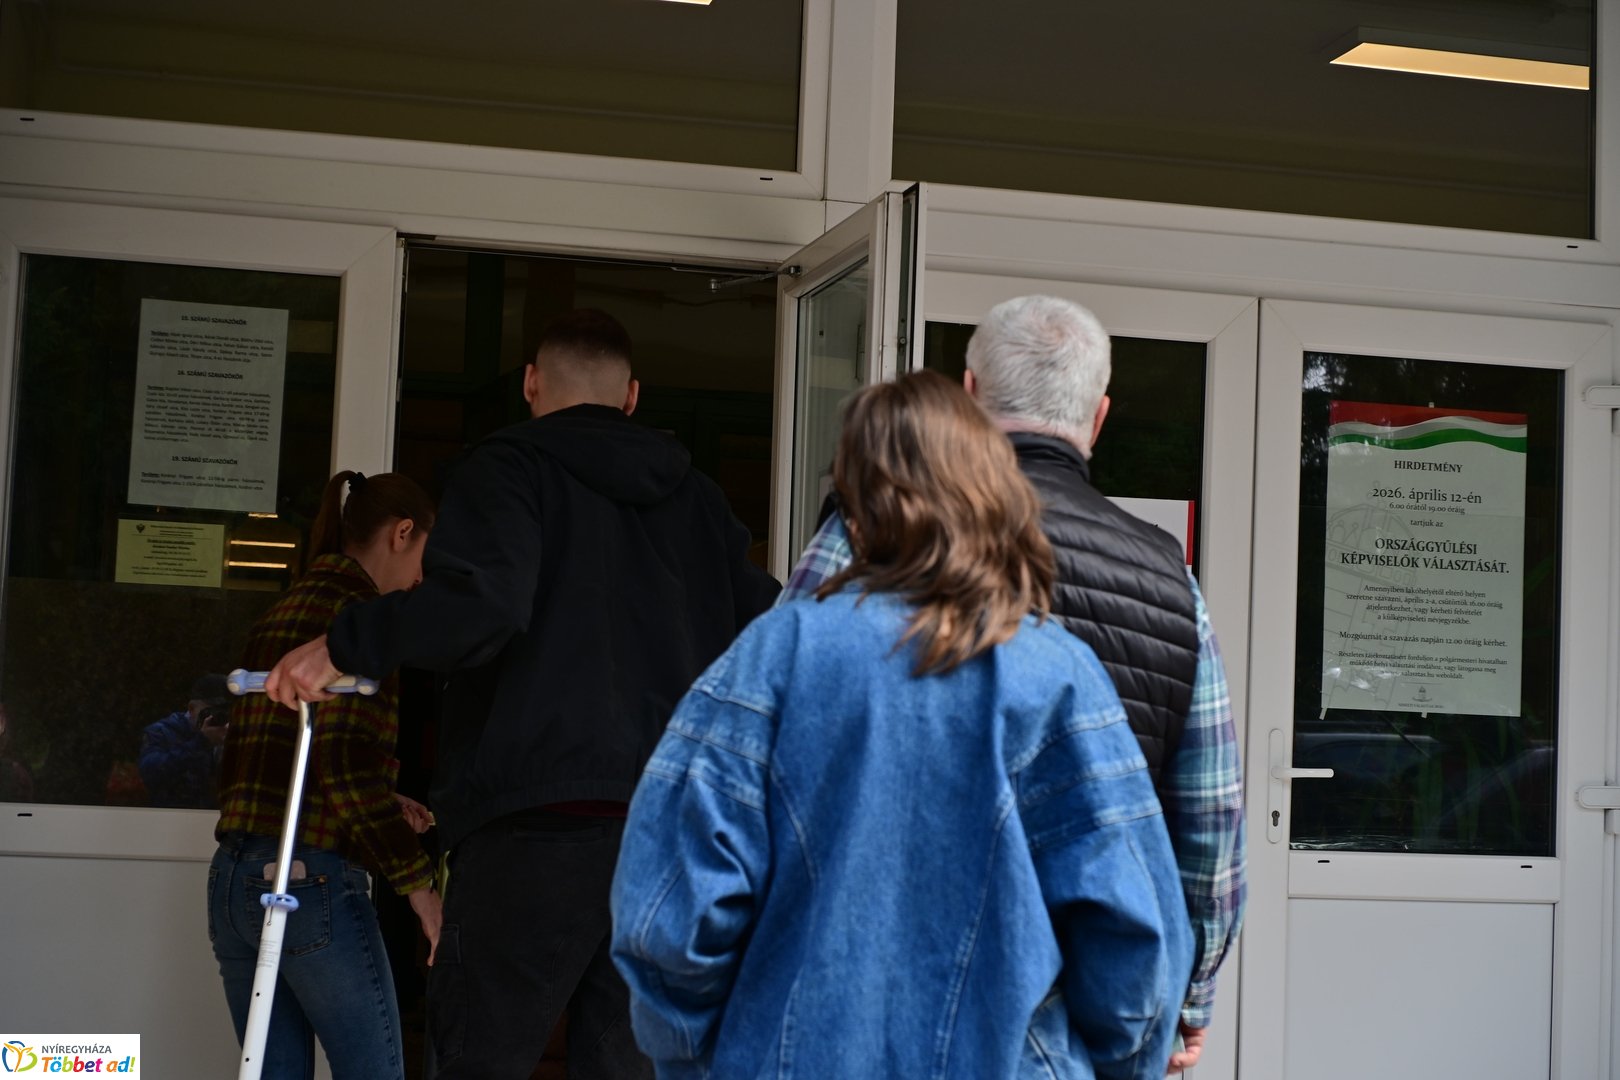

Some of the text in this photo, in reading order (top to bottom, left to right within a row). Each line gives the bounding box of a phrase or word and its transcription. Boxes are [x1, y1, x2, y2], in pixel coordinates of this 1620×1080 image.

[1394, 460, 1463, 473] HIRDETMÉNY
[1373, 487, 1482, 504] 2026. április 12-én
[1428, 506, 1446, 514] 19.00
[1447, 506, 1465, 515] óráig
[1410, 519, 1434, 528] tartjuk
[1375, 538, 1477, 555] ORSZÁGGYŰLÉSI
[1341, 552, 1510, 574] KÉPVISELŐK VÁLASZTÁSÁT.
[1364, 585, 1486, 599] Amennyiben lakóhelyétől eltérő helyen
[1374, 594, 1403, 603] szavazni,
[1404, 596, 1424, 604] április
[1438, 598, 1468, 606] csütörtök
[1366, 603, 1413, 613] átjelentkezhet,
[1430, 606, 1453, 615] kérheti
[1454, 607, 1483, 616] felvételét
[1383, 614, 1426, 623] külképviseleti
[1427, 617, 1471, 625] névjegyzékbe.
[1339, 631, 1382, 641] Mozgóurnát
[1389, 634, 1419, 643] szavazás
[1421, 636, 1444, 644] napján
[1463, 638, 1482, 647] óráig
[1483, 639, 1508, 647] kérhet.
[1408, 654, 1433, 662] forduljon
